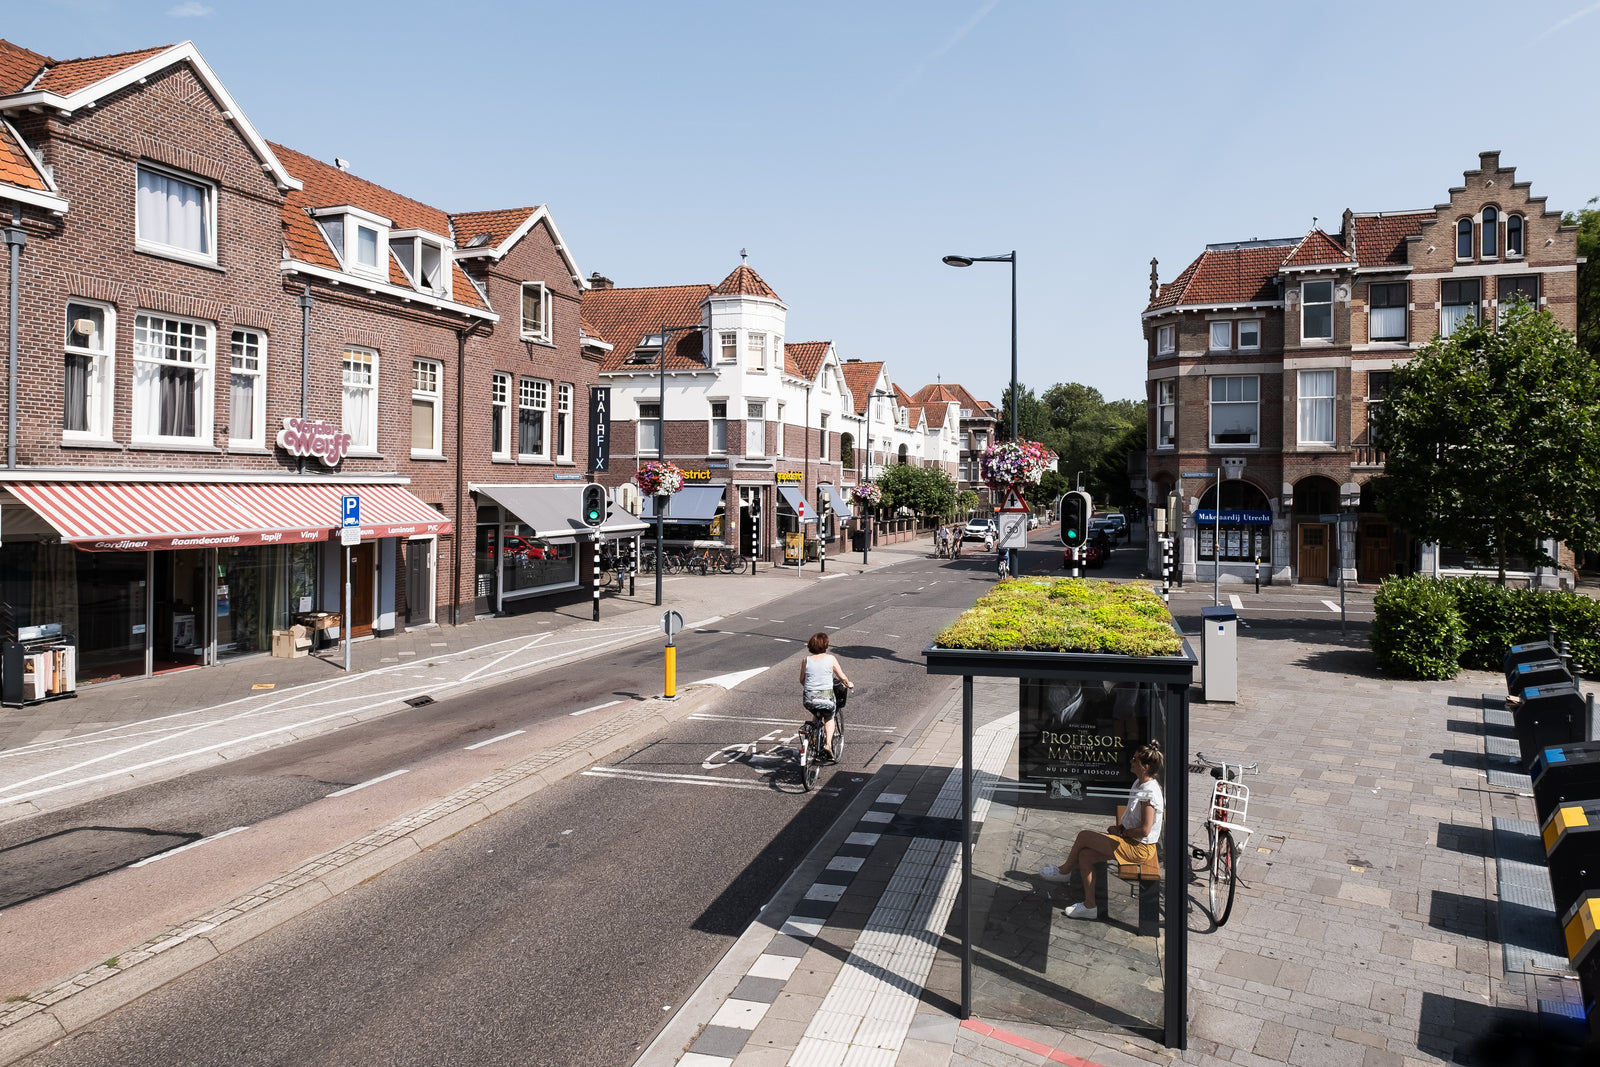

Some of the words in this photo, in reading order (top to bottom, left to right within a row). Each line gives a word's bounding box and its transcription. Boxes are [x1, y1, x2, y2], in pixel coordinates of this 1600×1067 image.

[595, 389, 606, 470] HAIRFIX
[283, 430, 352, 463] Werff
[682, 469, 711, 480] strict
[346, 498, 357, 515] P
[1198, 513, 1241, 523] Makeaardij
[1243, 513, 1270, 521] Utrecht
[94, 540, 149, 550] Gordijnen
[171, 534, 240, 547] Raamdecoratie
[260, 532, 282, 543] Tapijt
[300, 530, 319, 540] Vinyl
[387, 525, 416, 535] Laminaat
[427, 524, 439, 533] PVC
[1006, 525, 1019, 534] 30
[1041, 730, 1124, 748] PROFESSOR
[1047, 746, 1119, 763] MADMAN
